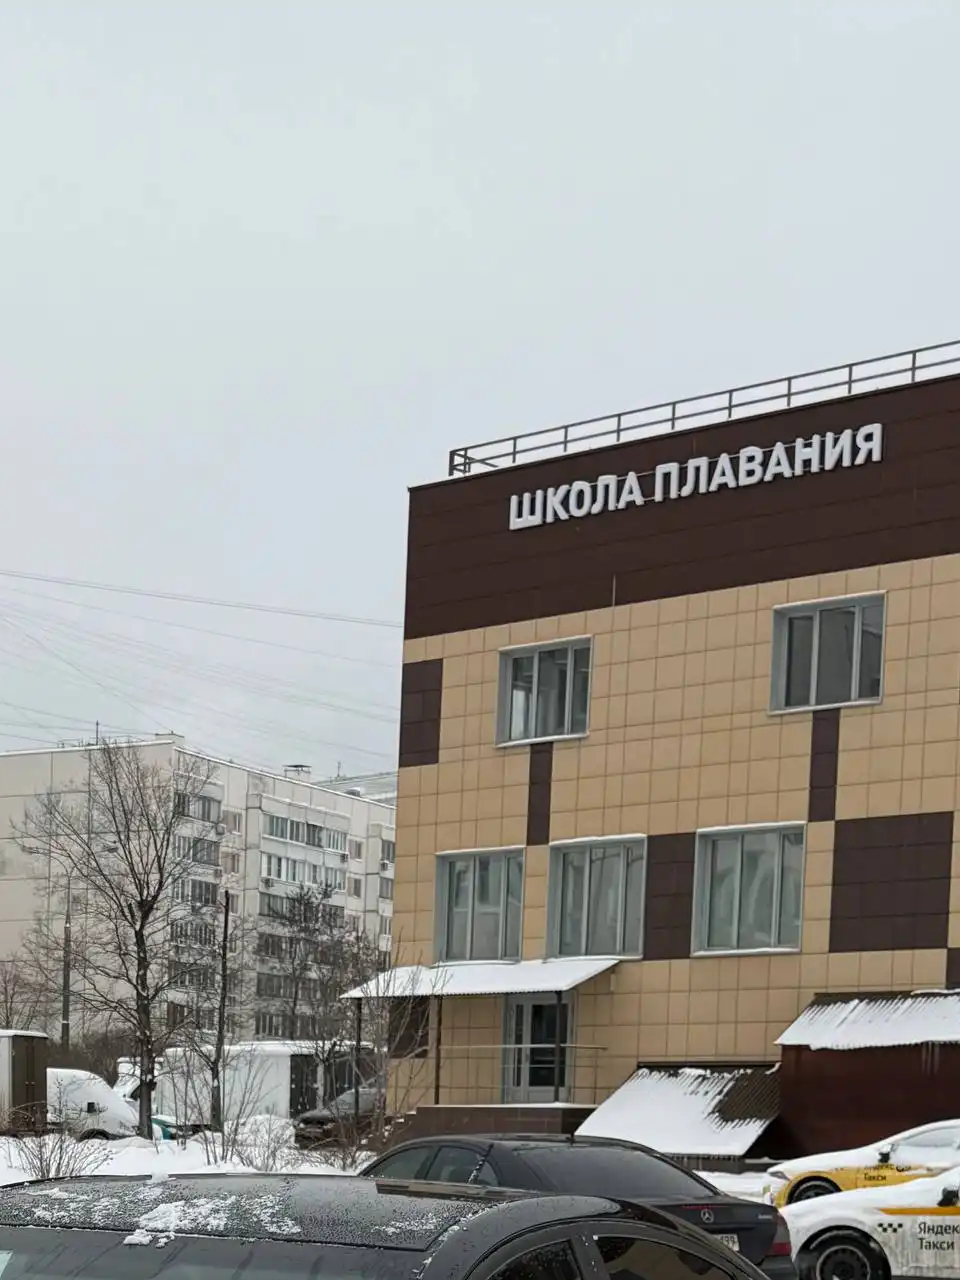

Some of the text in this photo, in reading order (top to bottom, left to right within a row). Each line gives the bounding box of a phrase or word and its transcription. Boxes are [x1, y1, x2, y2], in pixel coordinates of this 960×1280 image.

[509, 422, 883, 530] ШКОЛА ПЛАВАНИЯ
[917, 1238, 955, 1250] Такси
